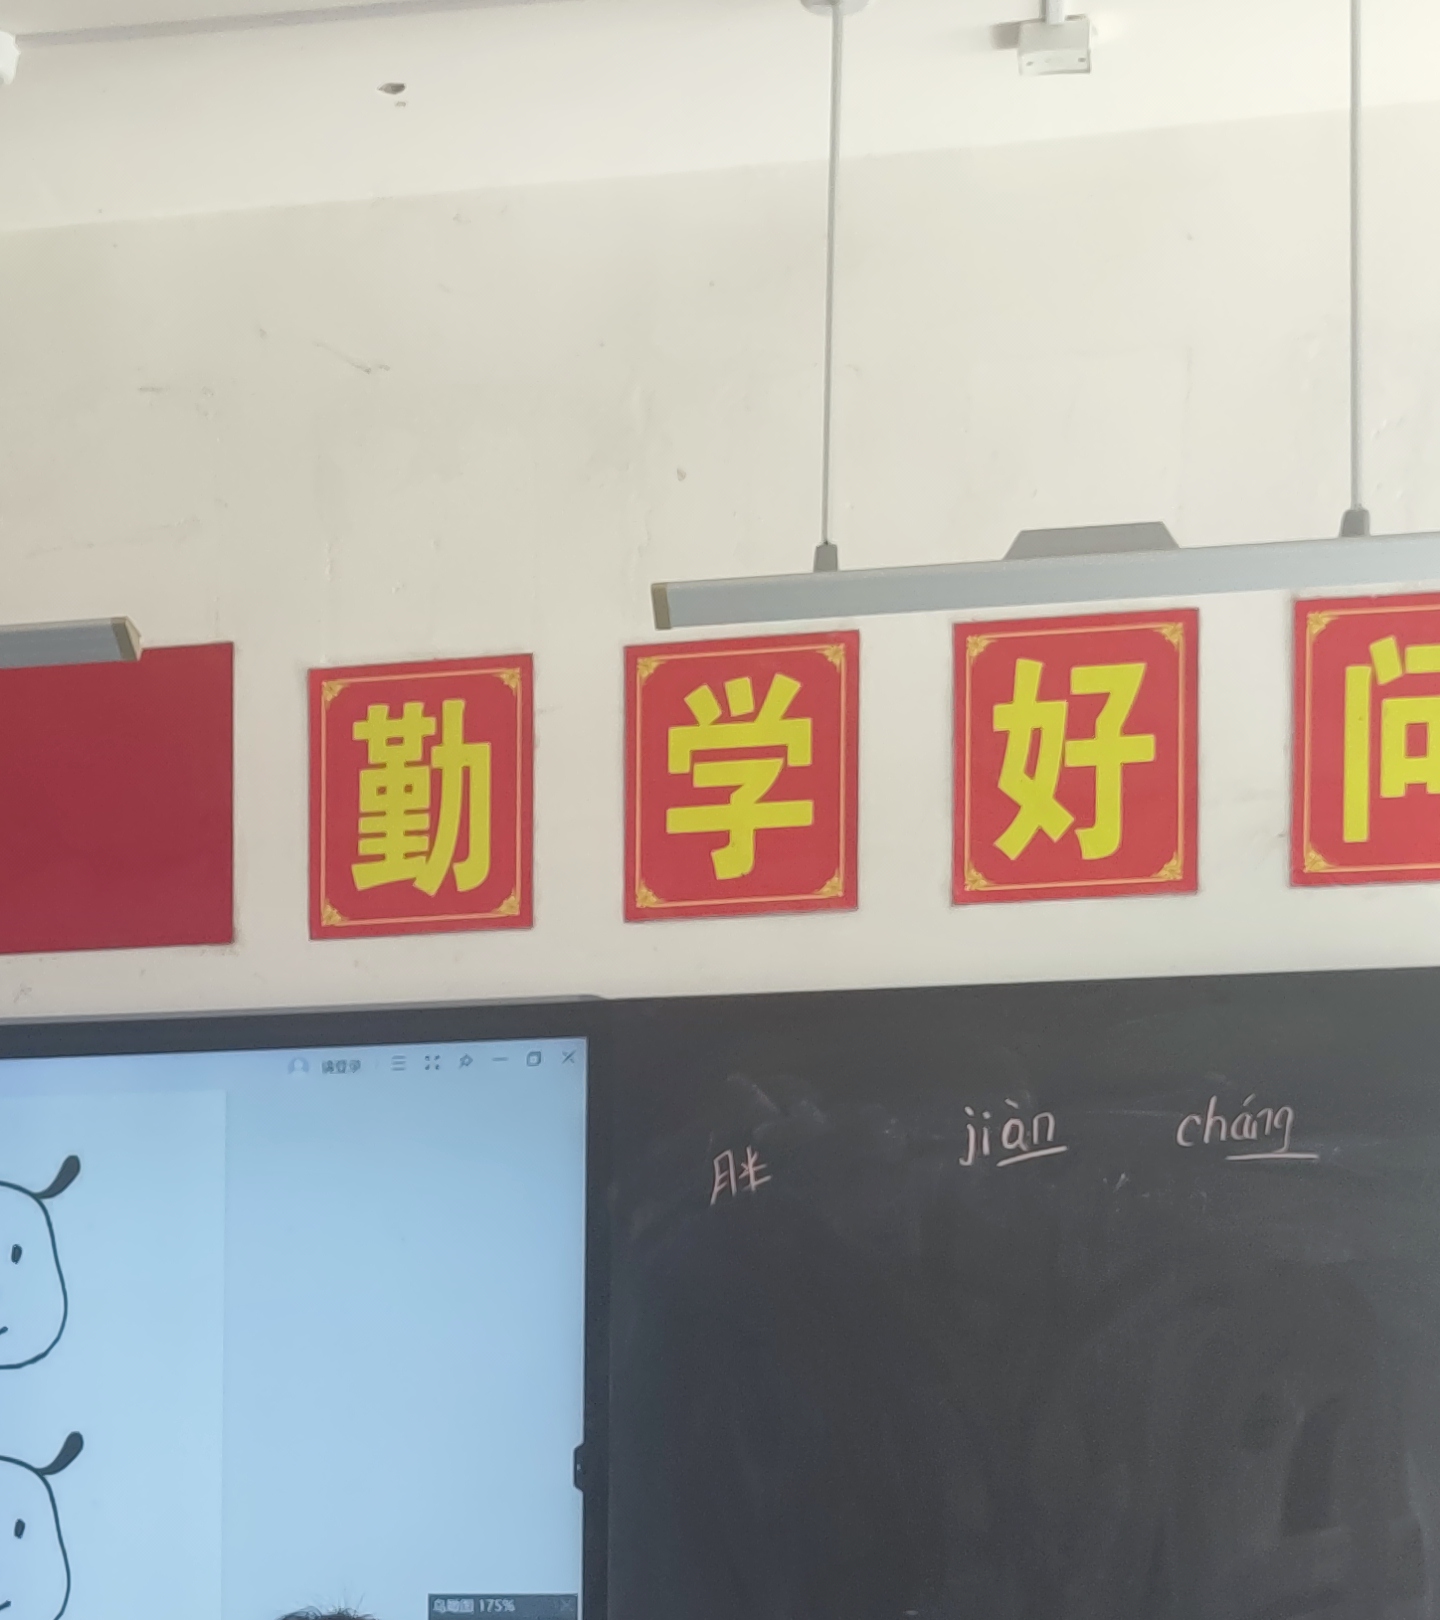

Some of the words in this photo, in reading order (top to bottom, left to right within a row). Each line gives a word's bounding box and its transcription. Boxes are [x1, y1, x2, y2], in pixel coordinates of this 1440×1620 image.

[352, 699, 490, 894] 勤
[666, 674, 814, 879] 学
[993, 659, 1156, 860] 好
[958, 1098, 1056, 1167] jiàn
